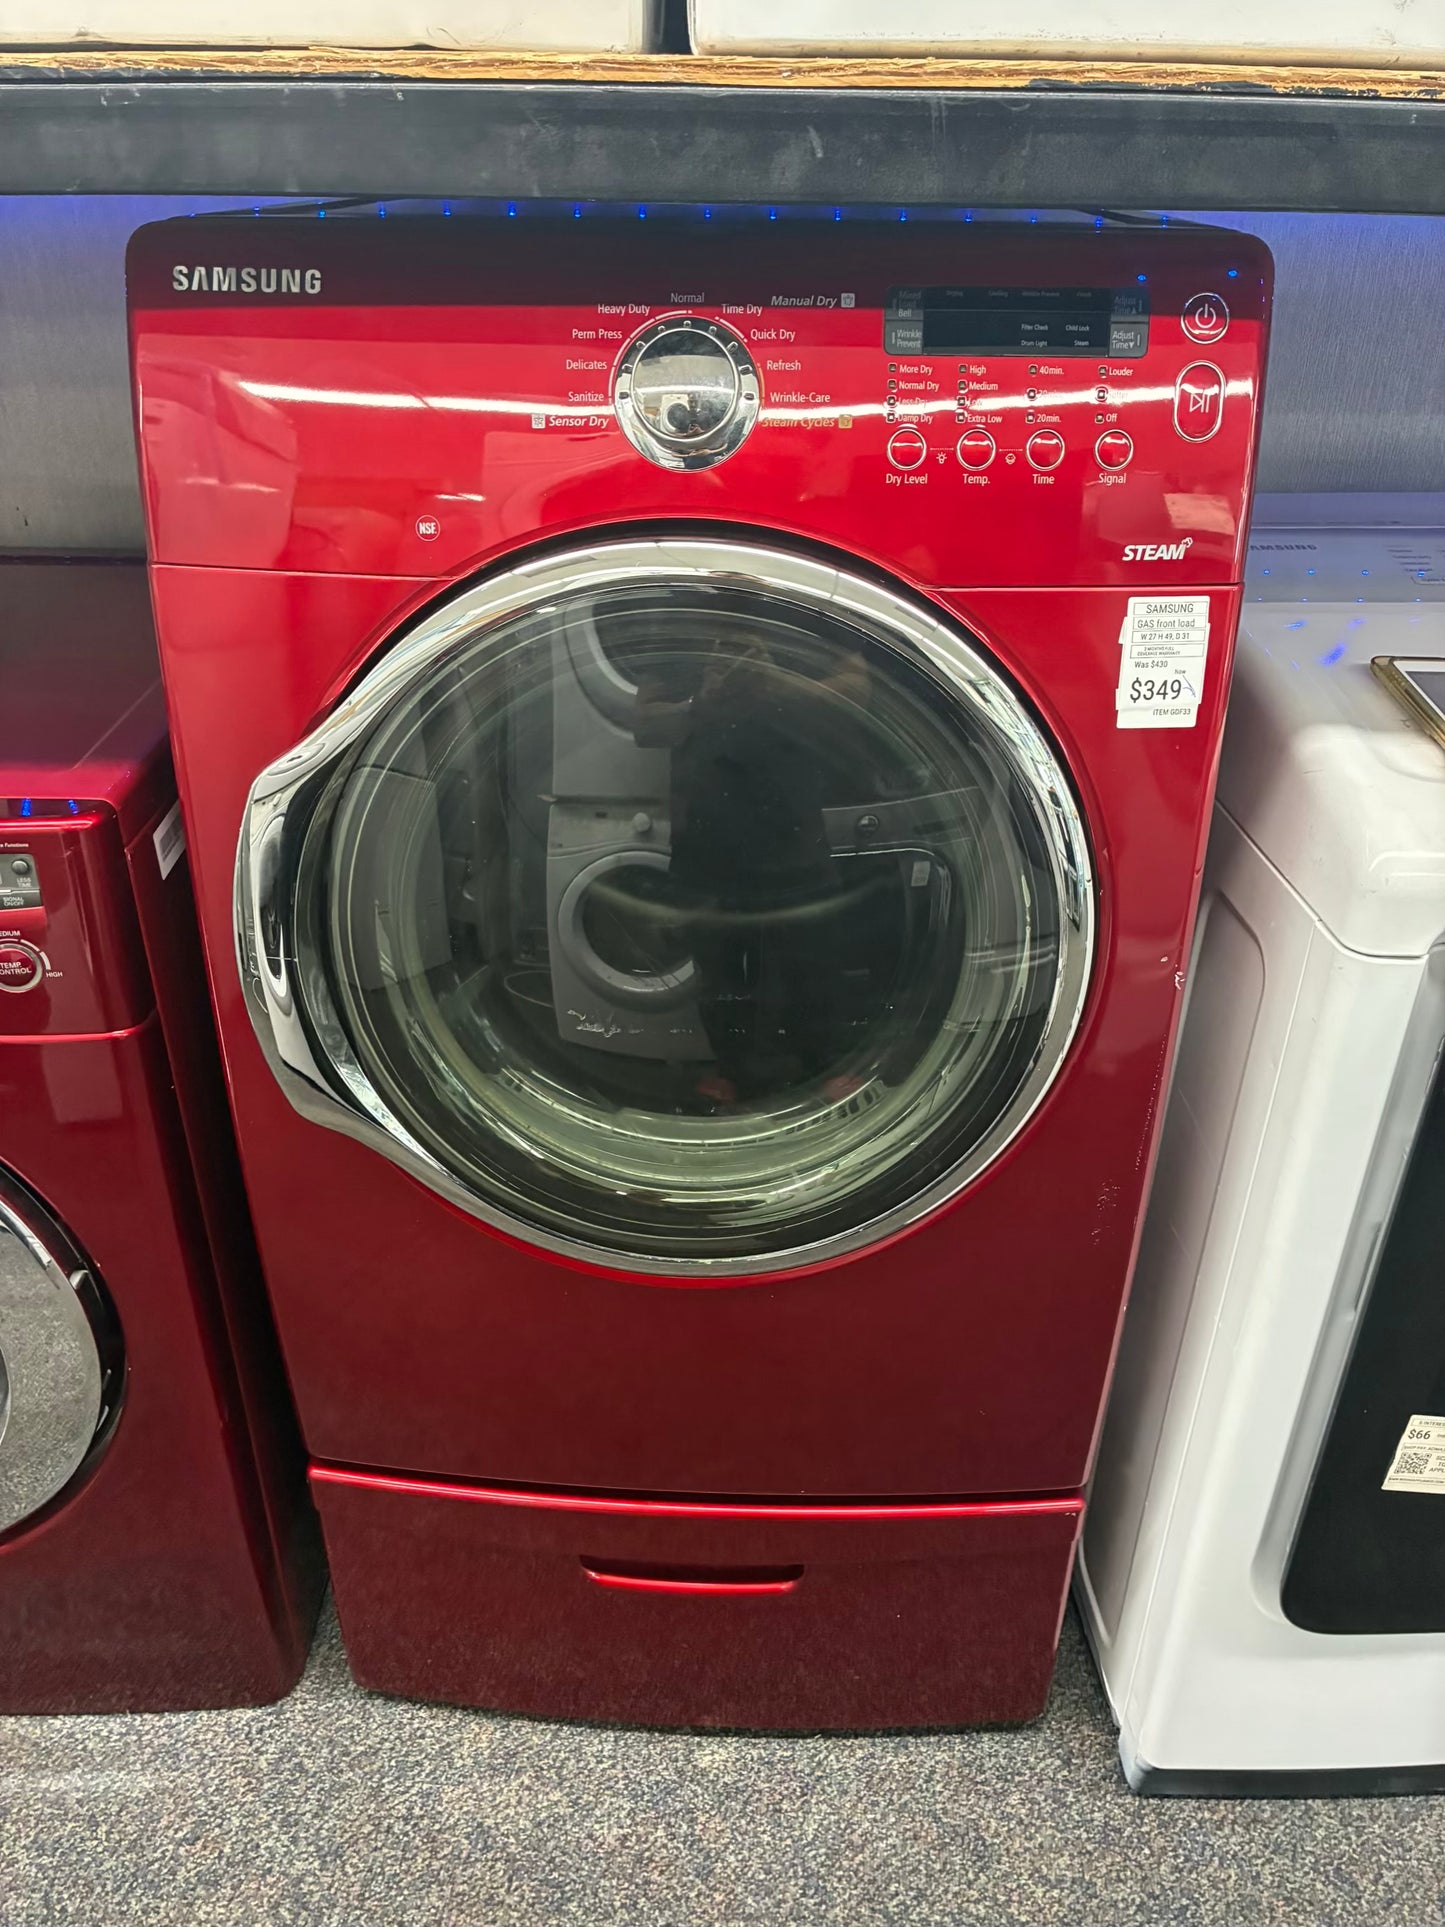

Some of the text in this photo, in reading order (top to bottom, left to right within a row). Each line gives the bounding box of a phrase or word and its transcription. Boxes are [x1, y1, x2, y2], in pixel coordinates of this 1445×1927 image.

[172, 265, 322, 294] SAMSUNG
[671, 293, 705, 303] Normal
[771, 295, 837, 308] Manual Dry
[598, 304, 650, 315] Heavy Duty
[722, 304, 762, 316] Time Dry
[572, 328, 622, 339] Perm Press
[750, 329, 795, 342] Quick Dry
[1112, 331, 1134, 341] Adjust
[566, 359, 607, 370] Delicates
[766, 360, 801, 371] Refresh
[900, 365, 933, 376] More Dry
[969, 365, 986, 376] High
[1040, 366, 1064, 375] 40min.
[1109, 367, 1133, 376] Louder
[899, 381, 940, 393] Normal Dry
[969, 382, 998, 391] Medium
[568, 392, 605, 402] Sanitize
[770, 392, 831, 403] Wrinkle-Care
[549, 416, 609, 429] Sensor Dry
[762, 417, 835, 430] Steam Cycles
[898, 414, 933, 425] Damp Dry
[968, 414, 1003, 423] Extra Low
[1037, 414, 1061, 423] 20min.
[1106, 414, 1117, 423] Off
[886, 473, 928, 486] Dry Level
[963, 474, 990, 486] Temp.
[1033, 474, 1055, 485] Time
[1099, 473, 1127, 486] Signal
[1122, 544, 1187, 561] STEAM
[1146, 604, 1194, 614] SAMSUNG
[1137, 618, 1195, 629] GAS front load
[1165, 633, 1174, 641] 49,
[1151, 661, 1168, 669] $430
[1130, 677, 1182, 704] $349
[0, 968, 31, 976] ONTROL
[1408, 1429, 1431, 1440] $66
